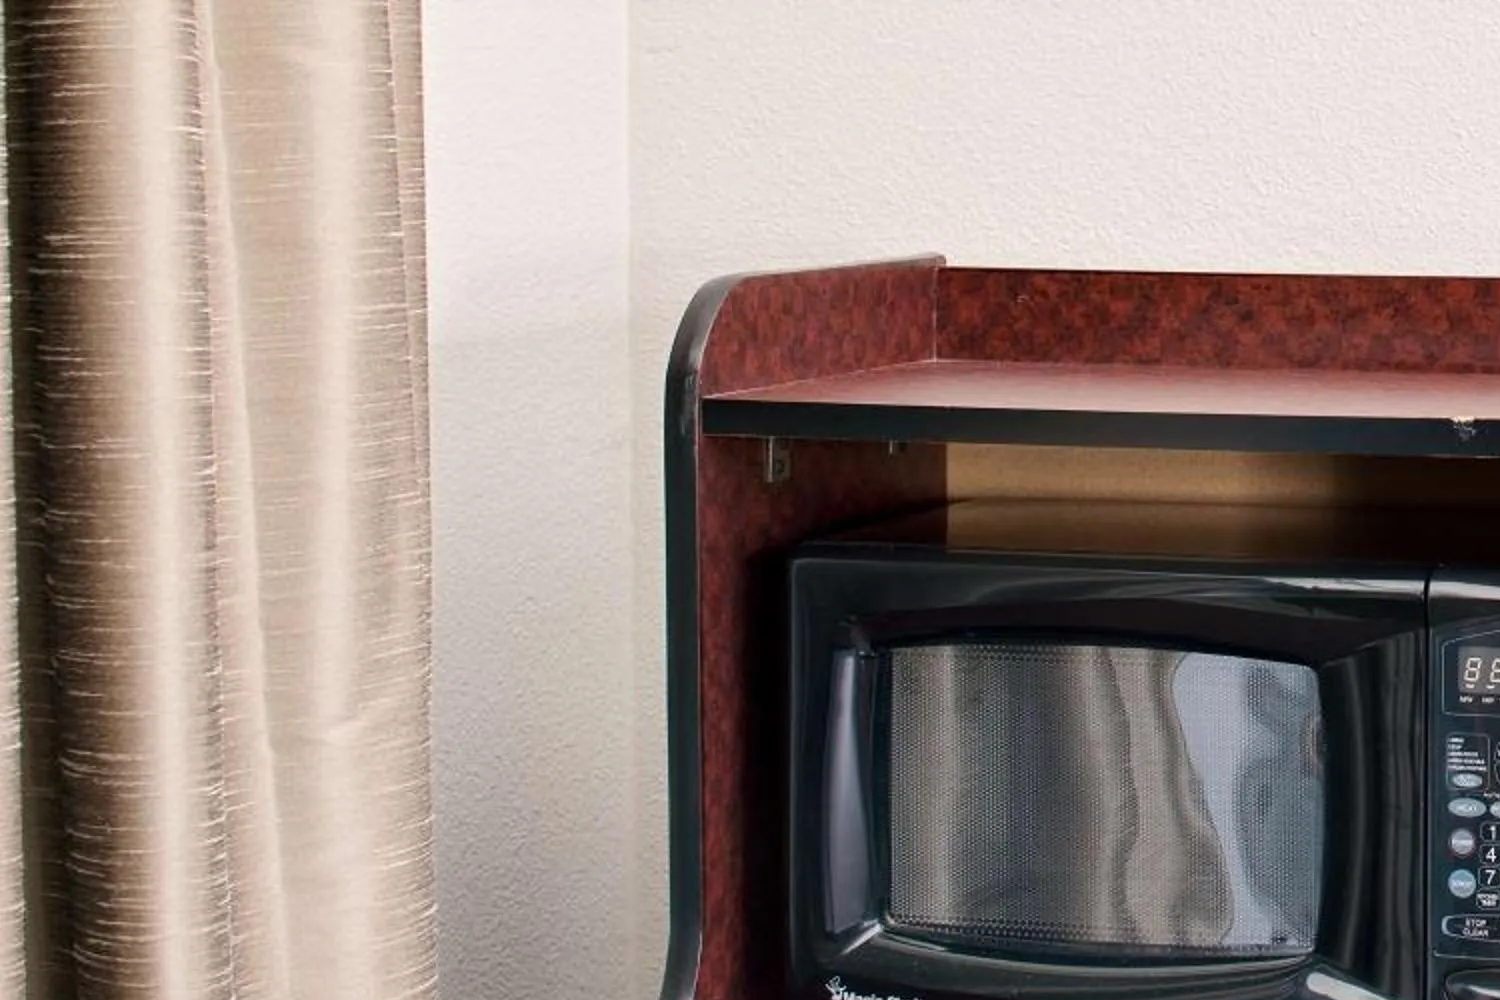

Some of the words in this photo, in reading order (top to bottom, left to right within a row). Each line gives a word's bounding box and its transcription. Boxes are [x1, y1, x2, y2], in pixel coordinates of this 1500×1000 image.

[1488, 826, 1497, 840] 1
[1486, 847, 1497, 862] 4
[1485, 869, 1496, 885] 7
[1465, 918, 1487, 927] STOP
